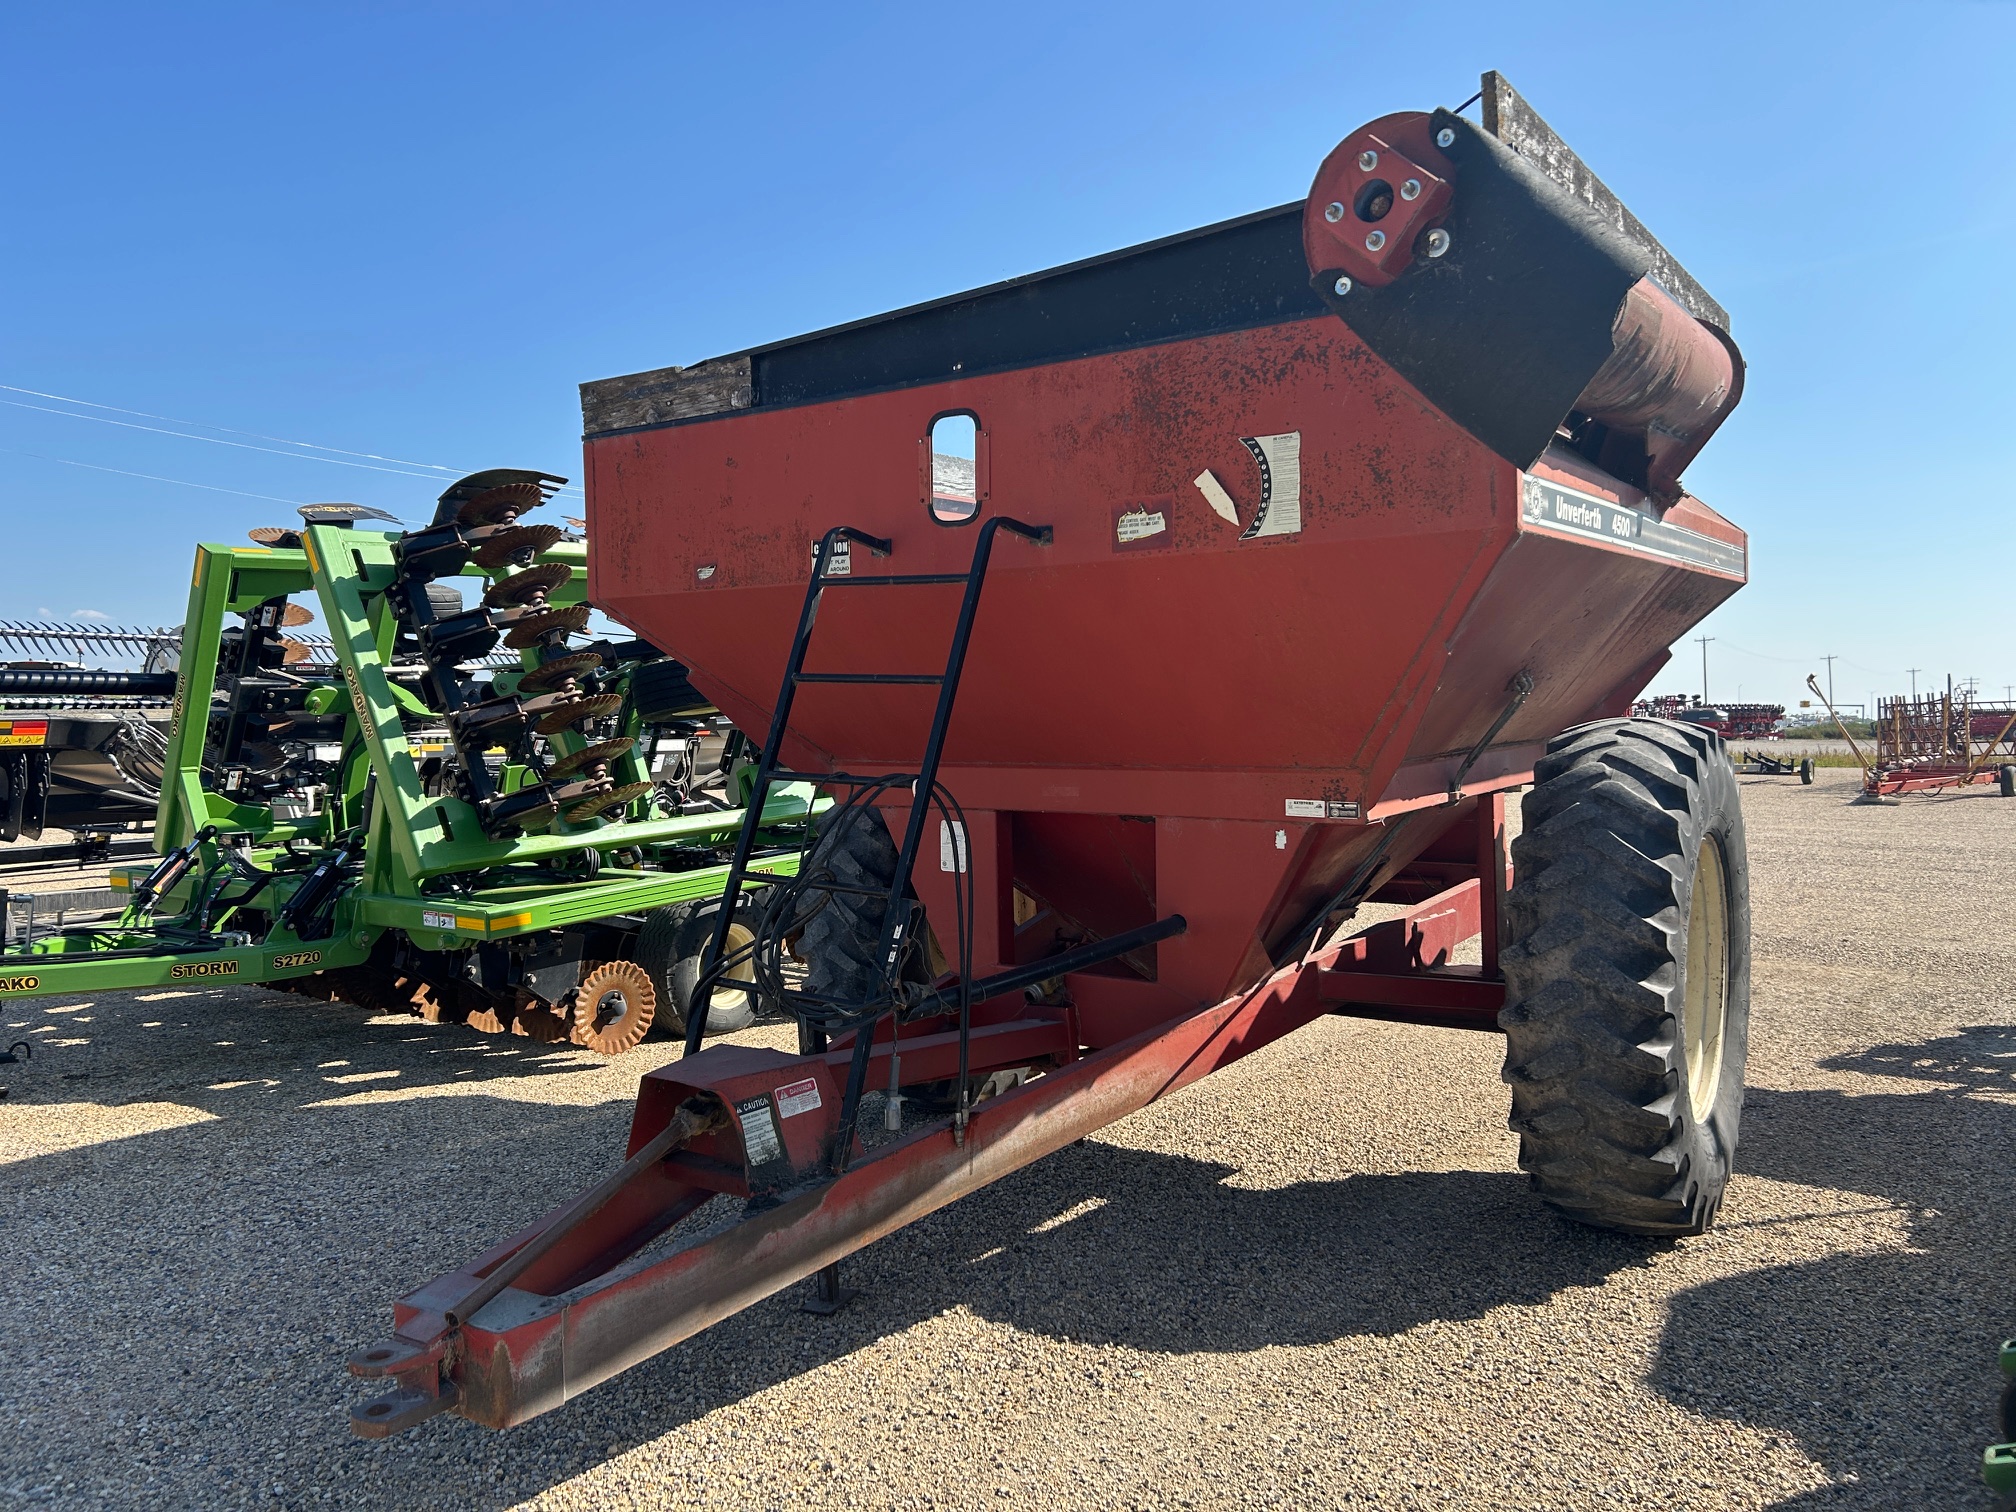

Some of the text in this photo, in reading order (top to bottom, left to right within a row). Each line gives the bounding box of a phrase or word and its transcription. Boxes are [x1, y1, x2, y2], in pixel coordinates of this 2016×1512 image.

[1556, 495, 1602, 530] Unverferth
[1611, 513, 1630, 538] 4500
[813, 542, 848, 555] CION
[172, 673, 186, 738] MANDAKO
[346, 665, 374, 740] MANDAKO
[171, 960, 238, 979] STORM
[273, 950, 322, 970] S2720
[789, 1083, 813, 1095] DANGER
